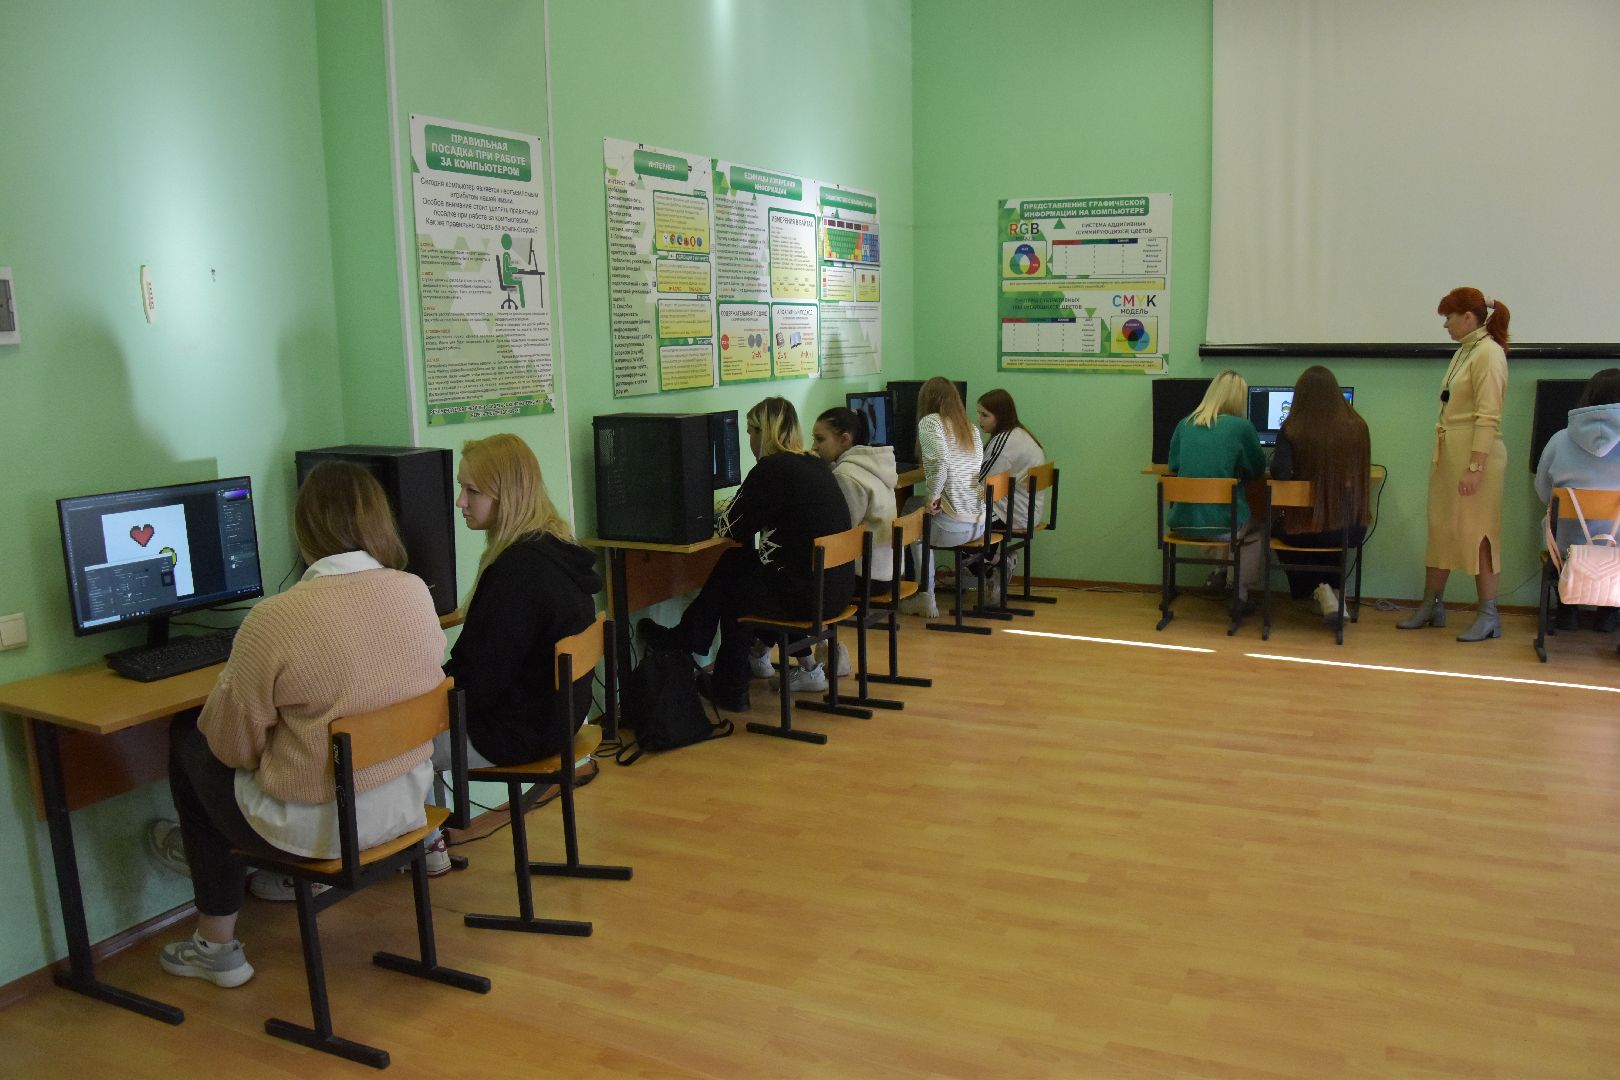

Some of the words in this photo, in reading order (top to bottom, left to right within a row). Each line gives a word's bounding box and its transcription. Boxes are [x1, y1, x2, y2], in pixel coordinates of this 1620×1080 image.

[451, 134, 508, 151] ПРАВИЛЬНАЯ
[431, 143, 474, 158] ПОСАДКА
[476, 150, 493, 161] ПРИ
[495, 153, 526, 166] РАБОТЕ
[440, 157, 452, 167] ЗА
[454, 159, 520, 177] КОМПЬЮТЕРОМ
[1023, 201, 1087, 209] ПРЕДСТАВЛЕНИЕ
[1089, 199, 1146, 207] ГРАФИЧЕСКОЙ
[1024, 210, 1077, 218] ИНФОРМАЦИИ
[1009, 222, 1040, 236] RGB
[1112, 294, 1157, 307] CMYK
[1120, 308, 1149, 316] МОДЕЛЬ
